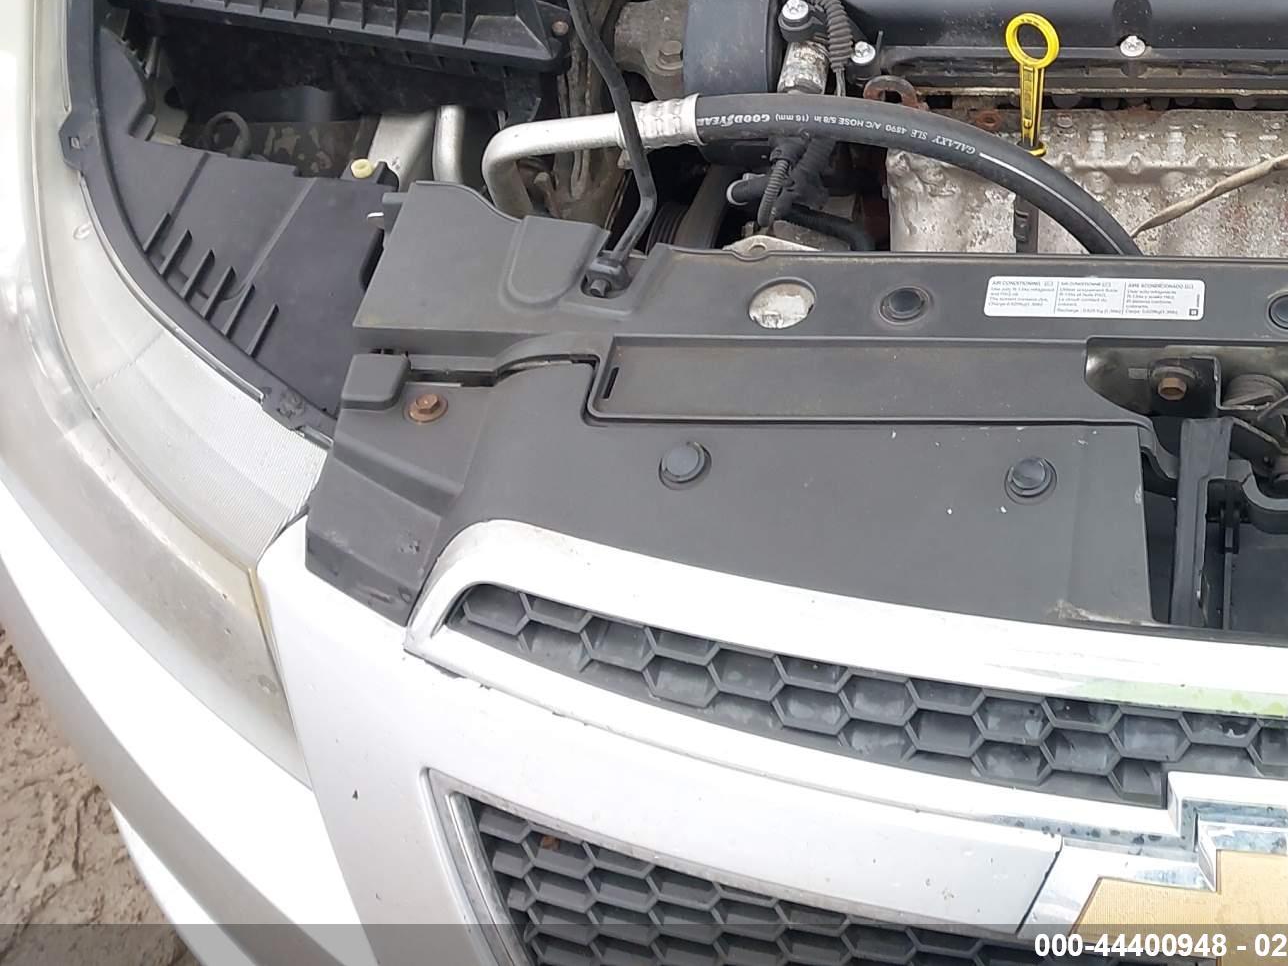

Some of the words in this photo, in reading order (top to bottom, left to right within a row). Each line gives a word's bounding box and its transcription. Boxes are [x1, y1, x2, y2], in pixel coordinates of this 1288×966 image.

[775, 113, 794, 123] mm)
[823, 114, 837, 124] 5/8
[838, 115, 864, 128] HOSE
[865, 118, 882, 131] A/C
[932, 135, 976, 155] GALAXY
